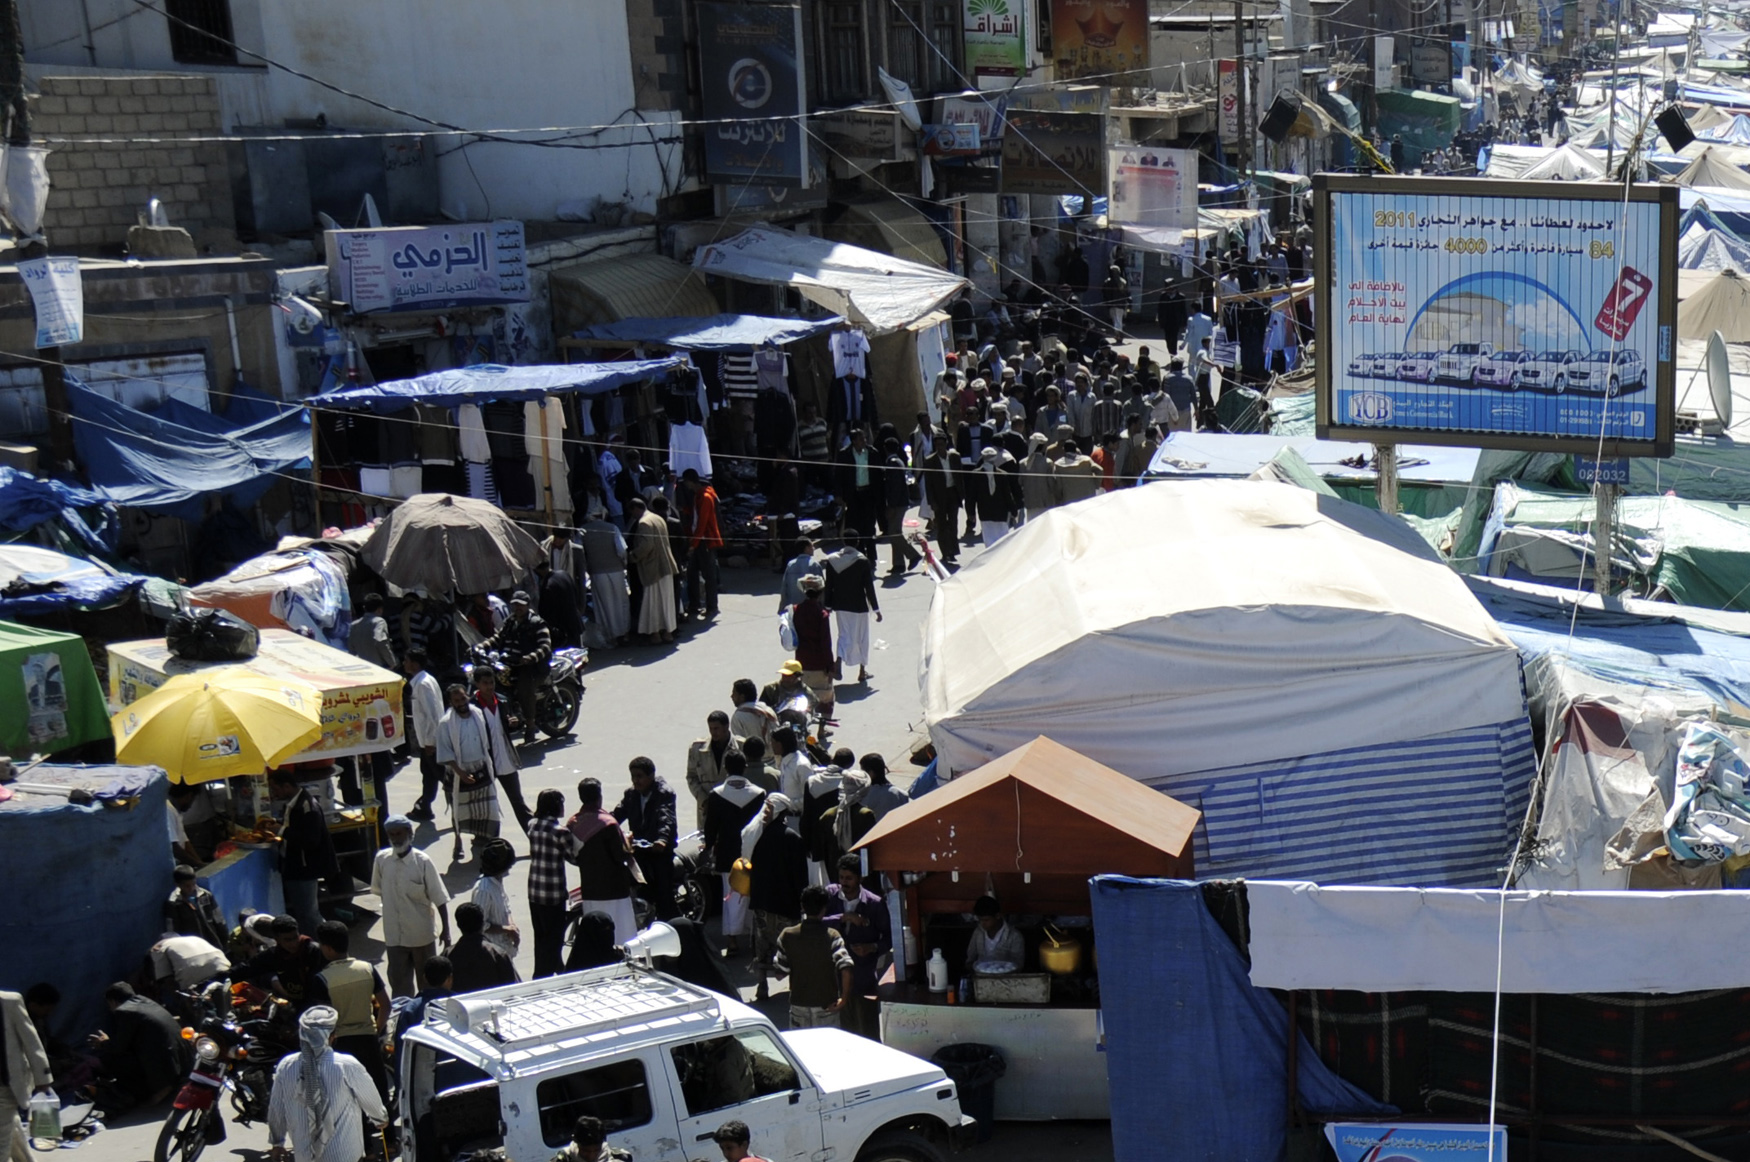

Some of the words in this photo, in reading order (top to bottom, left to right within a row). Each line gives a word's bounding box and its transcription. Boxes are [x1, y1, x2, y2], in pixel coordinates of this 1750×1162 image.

[1374, 210, 1416, 229] 2011
[1462, 215, 1497, 229] جواهر
[1500, 217, 1516, 232] مع
[1443, 237, 1488, 255] 4000
[1588, 240, 1615, 260] 84
[392, 231, 489, 279] الحزمي
[394, 281, 433, 298] الطلابية
[435, 278, 478, 295] للخدمات
[1617, 278, 1645, 314] 7
[1348, 312, 1376, 326] العام
[1378, 313, 1406, 327] نهاية
[1352, 393, 1390, 420] YCB
